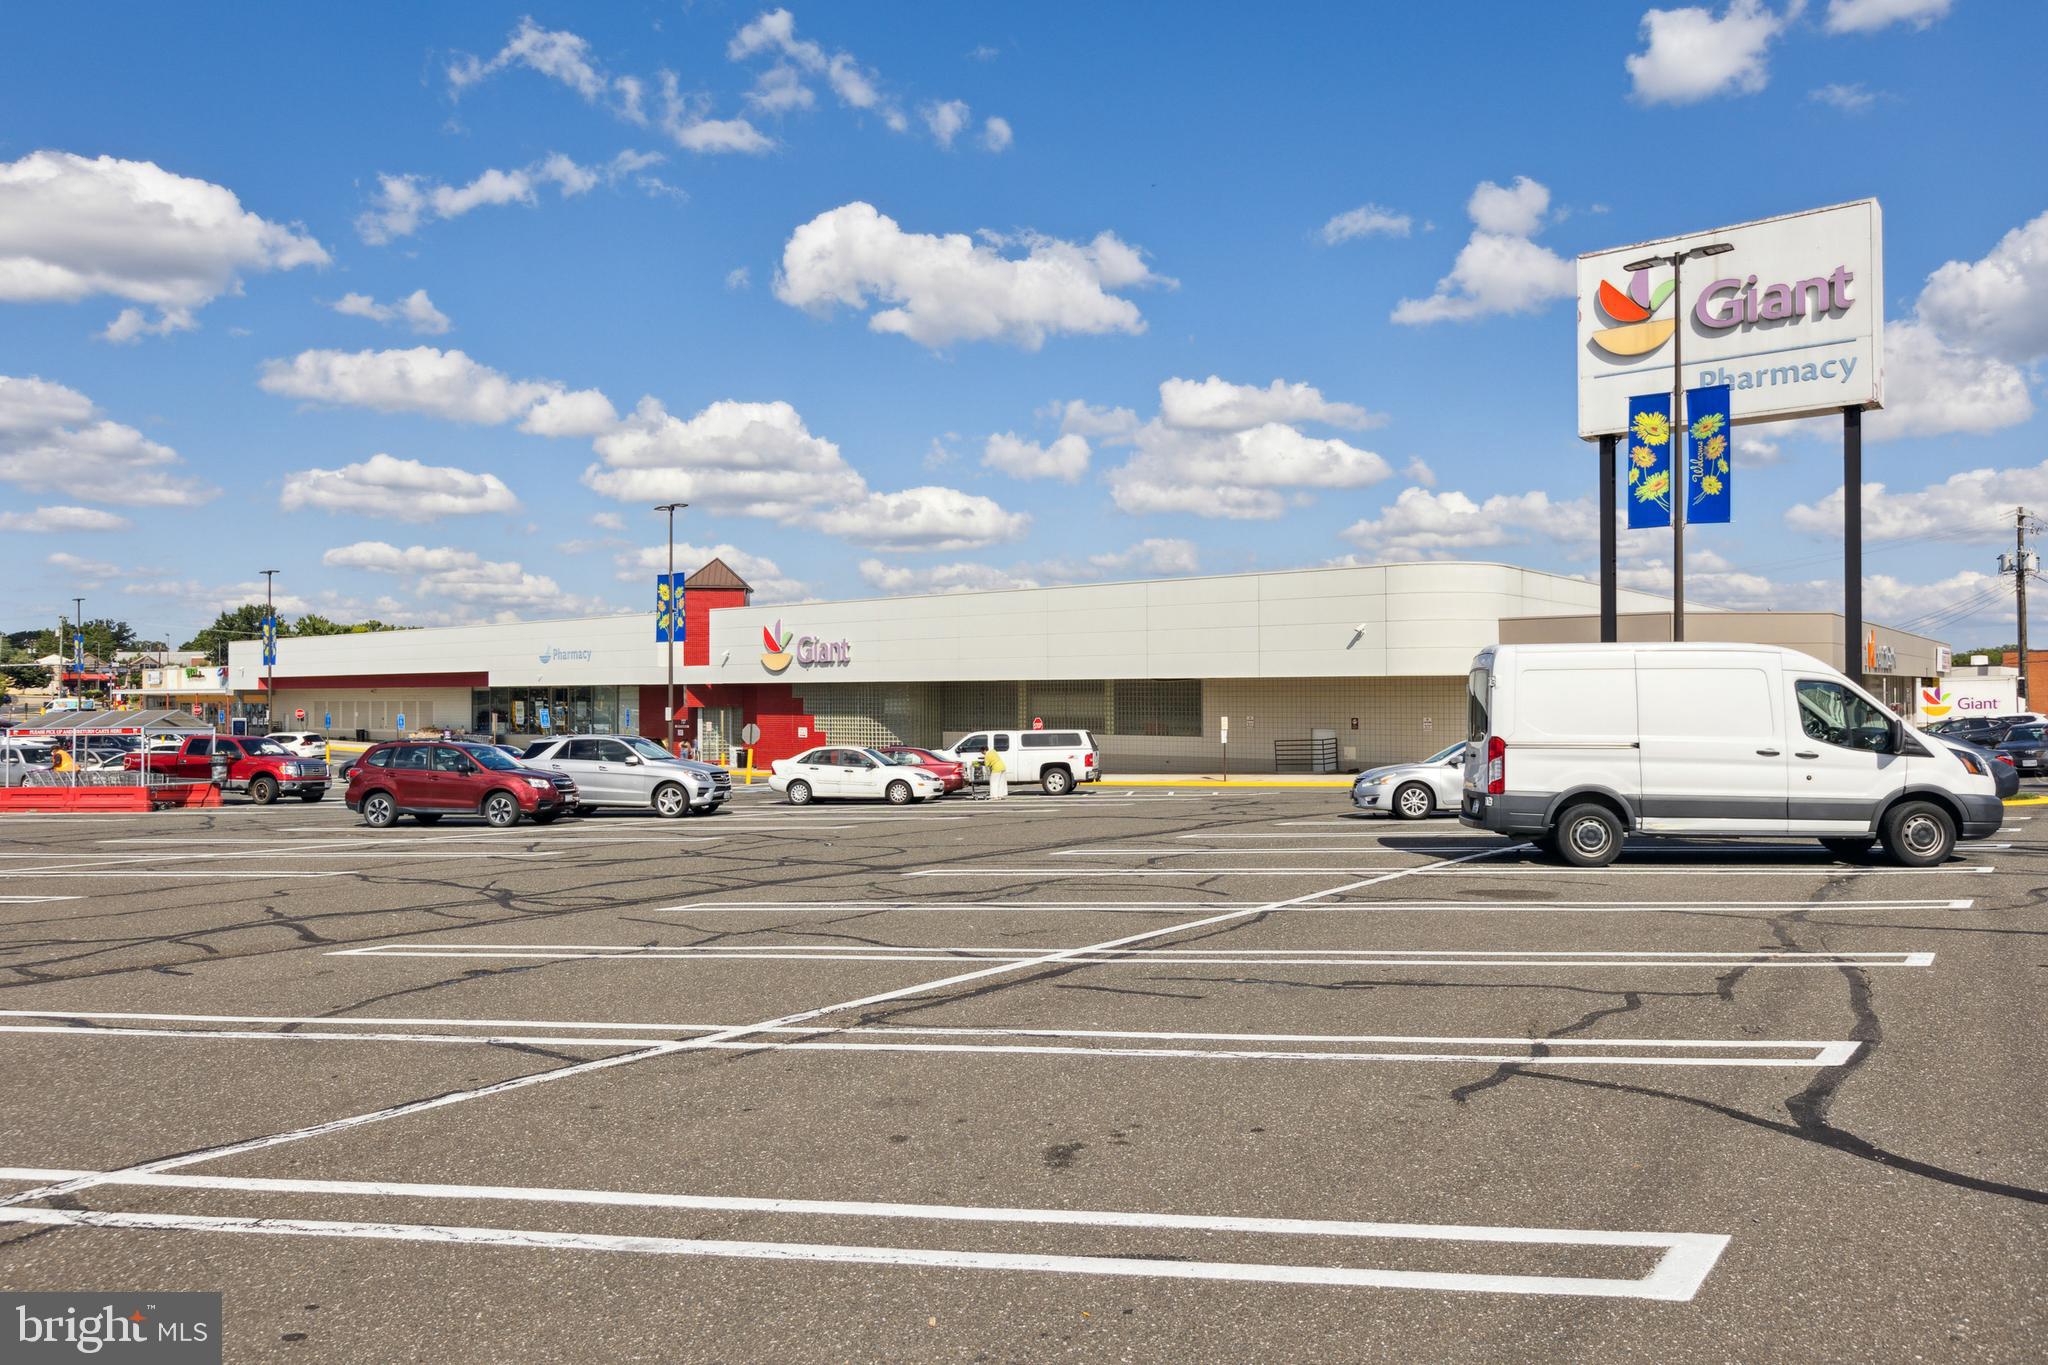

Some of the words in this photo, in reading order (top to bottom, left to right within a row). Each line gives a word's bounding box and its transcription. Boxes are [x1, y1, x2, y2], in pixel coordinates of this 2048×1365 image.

[1696, 265, 1855, 328] Giant
[553, 648, 592, 662] Pharmacy
[797, 636, 850, 665] Giant
[1957, 697, 1999, 710] Giant
